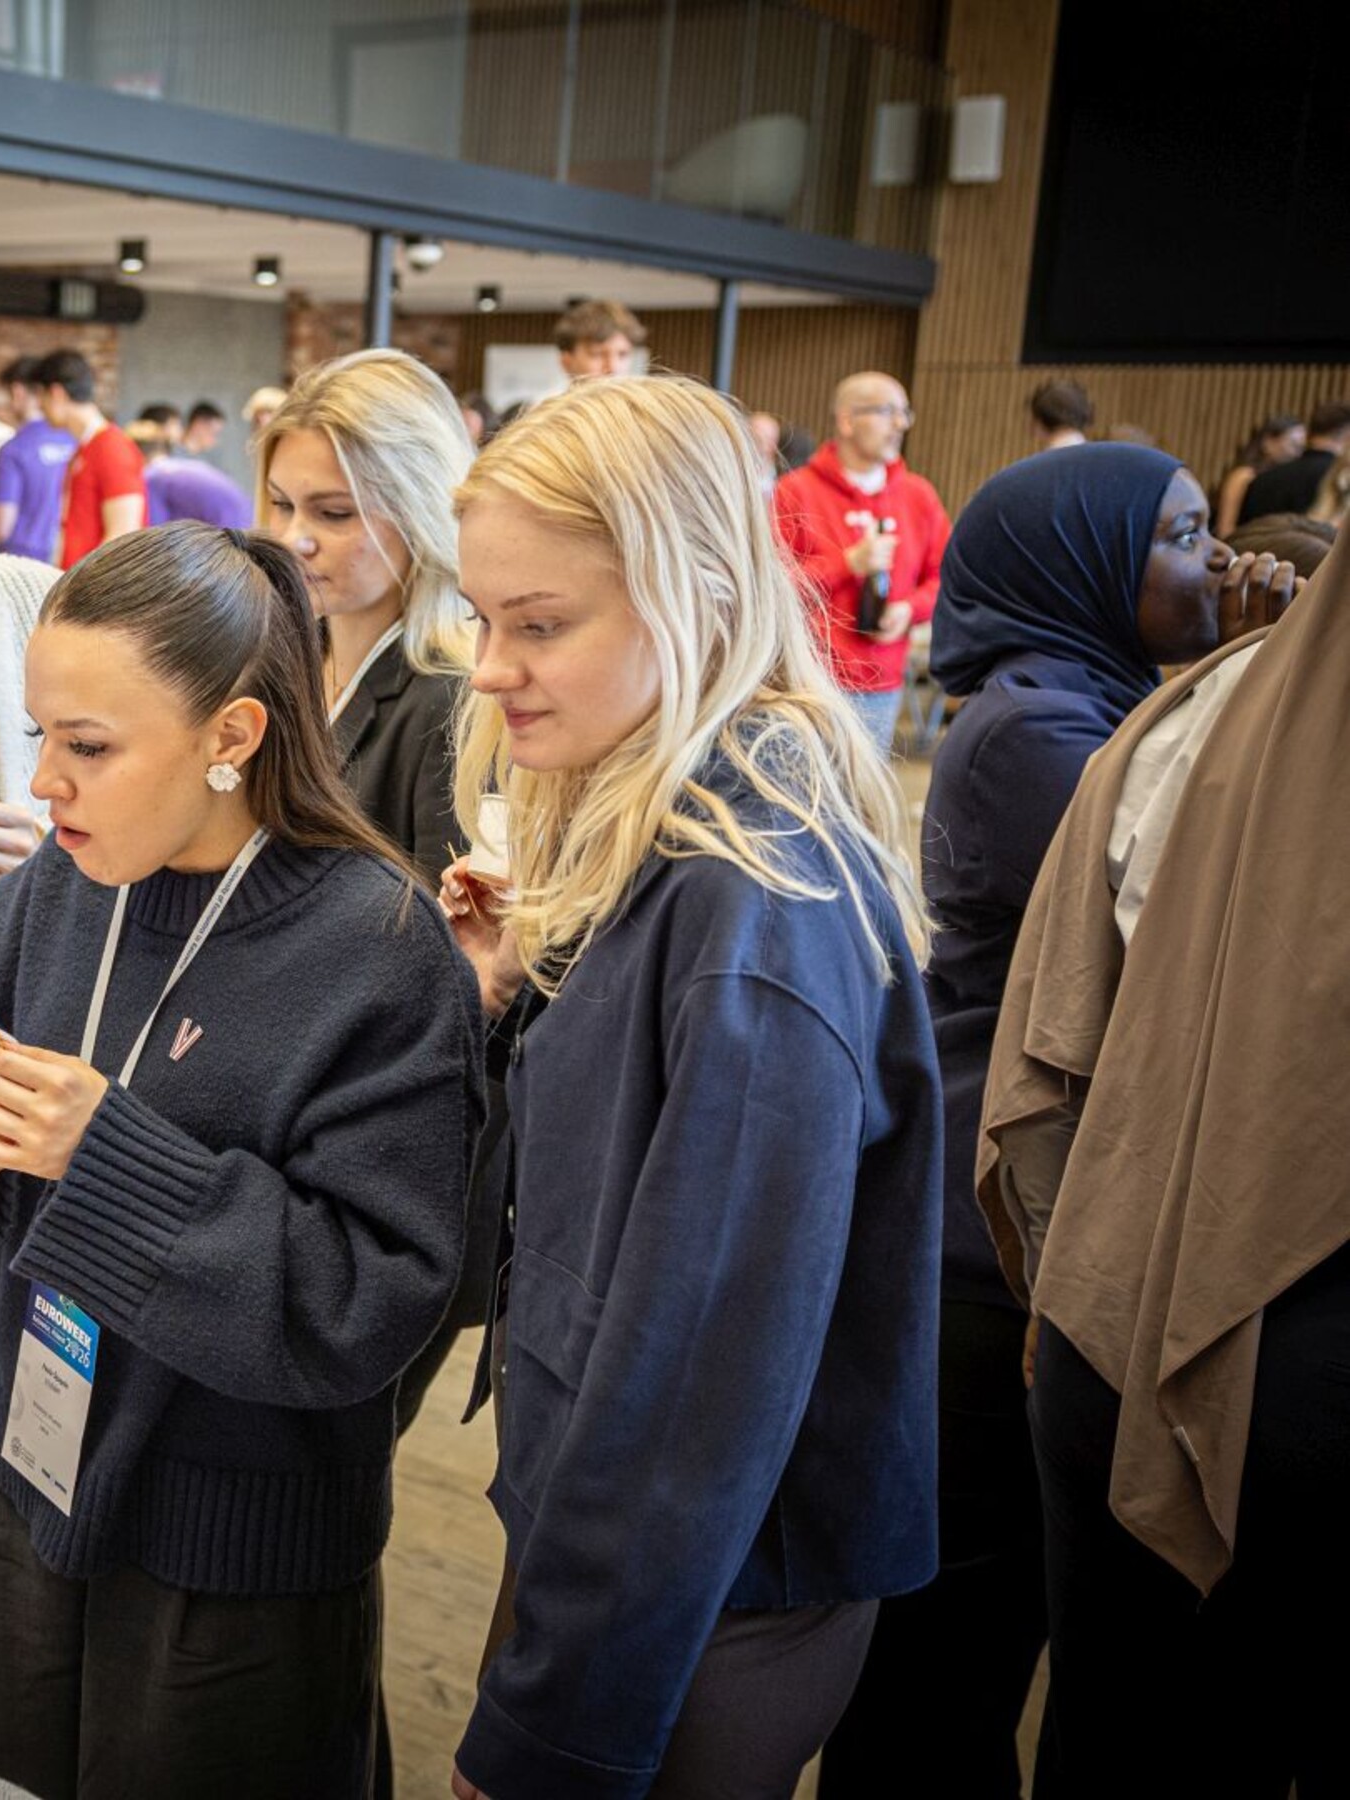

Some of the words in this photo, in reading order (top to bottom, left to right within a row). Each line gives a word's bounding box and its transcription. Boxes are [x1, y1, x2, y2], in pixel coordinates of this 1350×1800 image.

[222, 865, 243, 894] University
[199, 902, 221, 935] Economics
[34, 1294, 92, 1351] EUROWEEK
